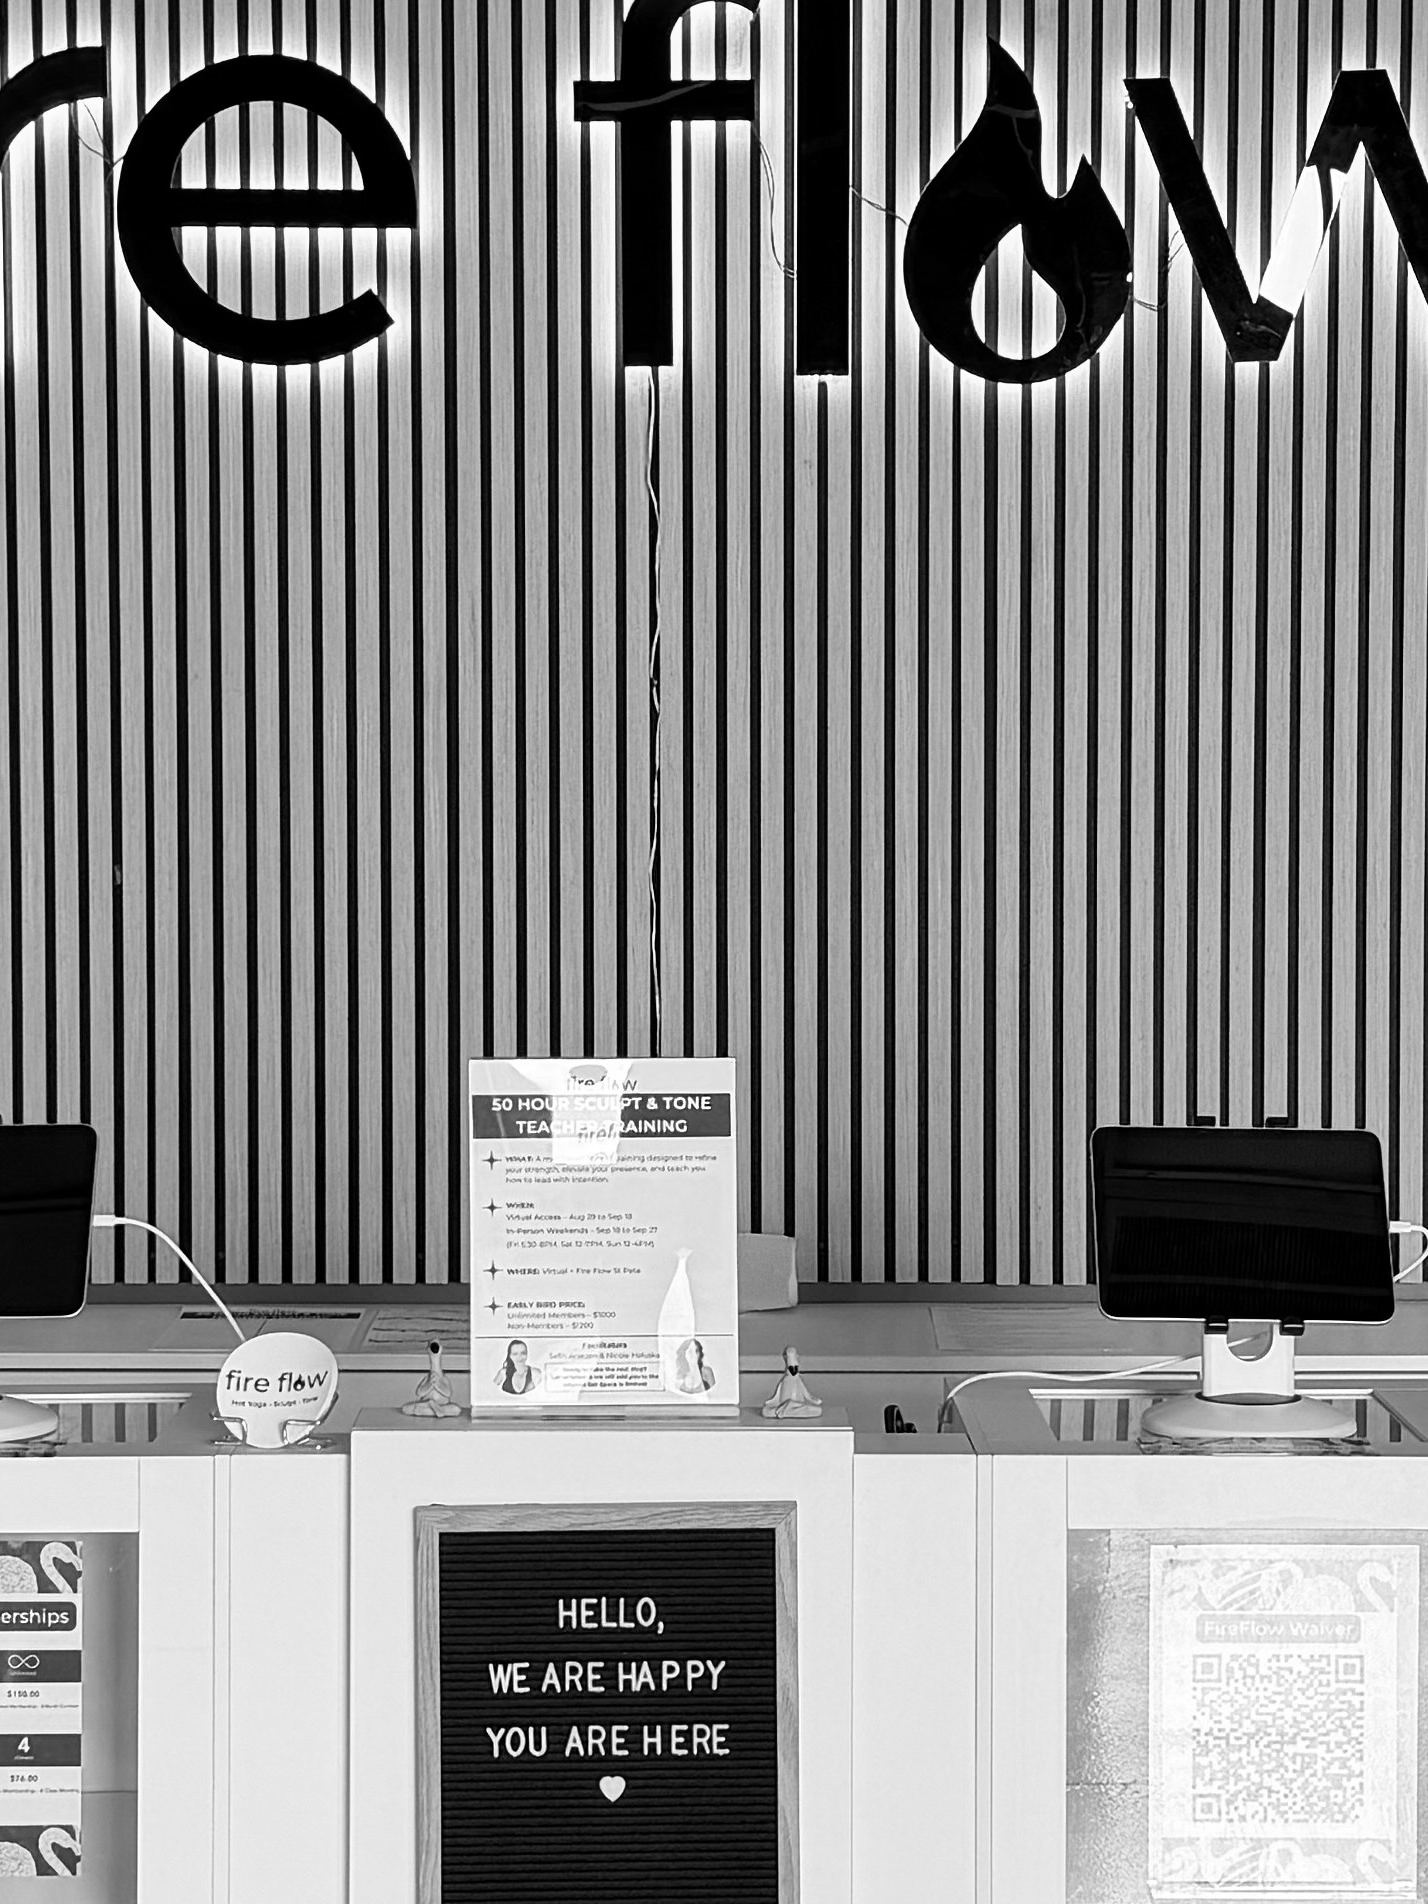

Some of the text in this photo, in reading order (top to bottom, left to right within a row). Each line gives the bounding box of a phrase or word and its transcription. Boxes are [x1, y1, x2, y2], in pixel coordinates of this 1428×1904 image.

[491, 1097, 513, 1111] 50
[518, 1097, 568, 1111] HOUR
[647, 1097, 659, 1109] &
[663, 1096, 712, 1109] TONE
[225, 1370, 270, 1393] fire
[559, 1597, 664, 1634] HELLO,
[1204, 1620, 1356, 1637] FireFlow Waiver
[489, 1660, 726, 1694] WE ARE HAPPY
[18, 1737, 30, 1753] 4
[486, 1724, 730, 1758] YOU ARE HERE
